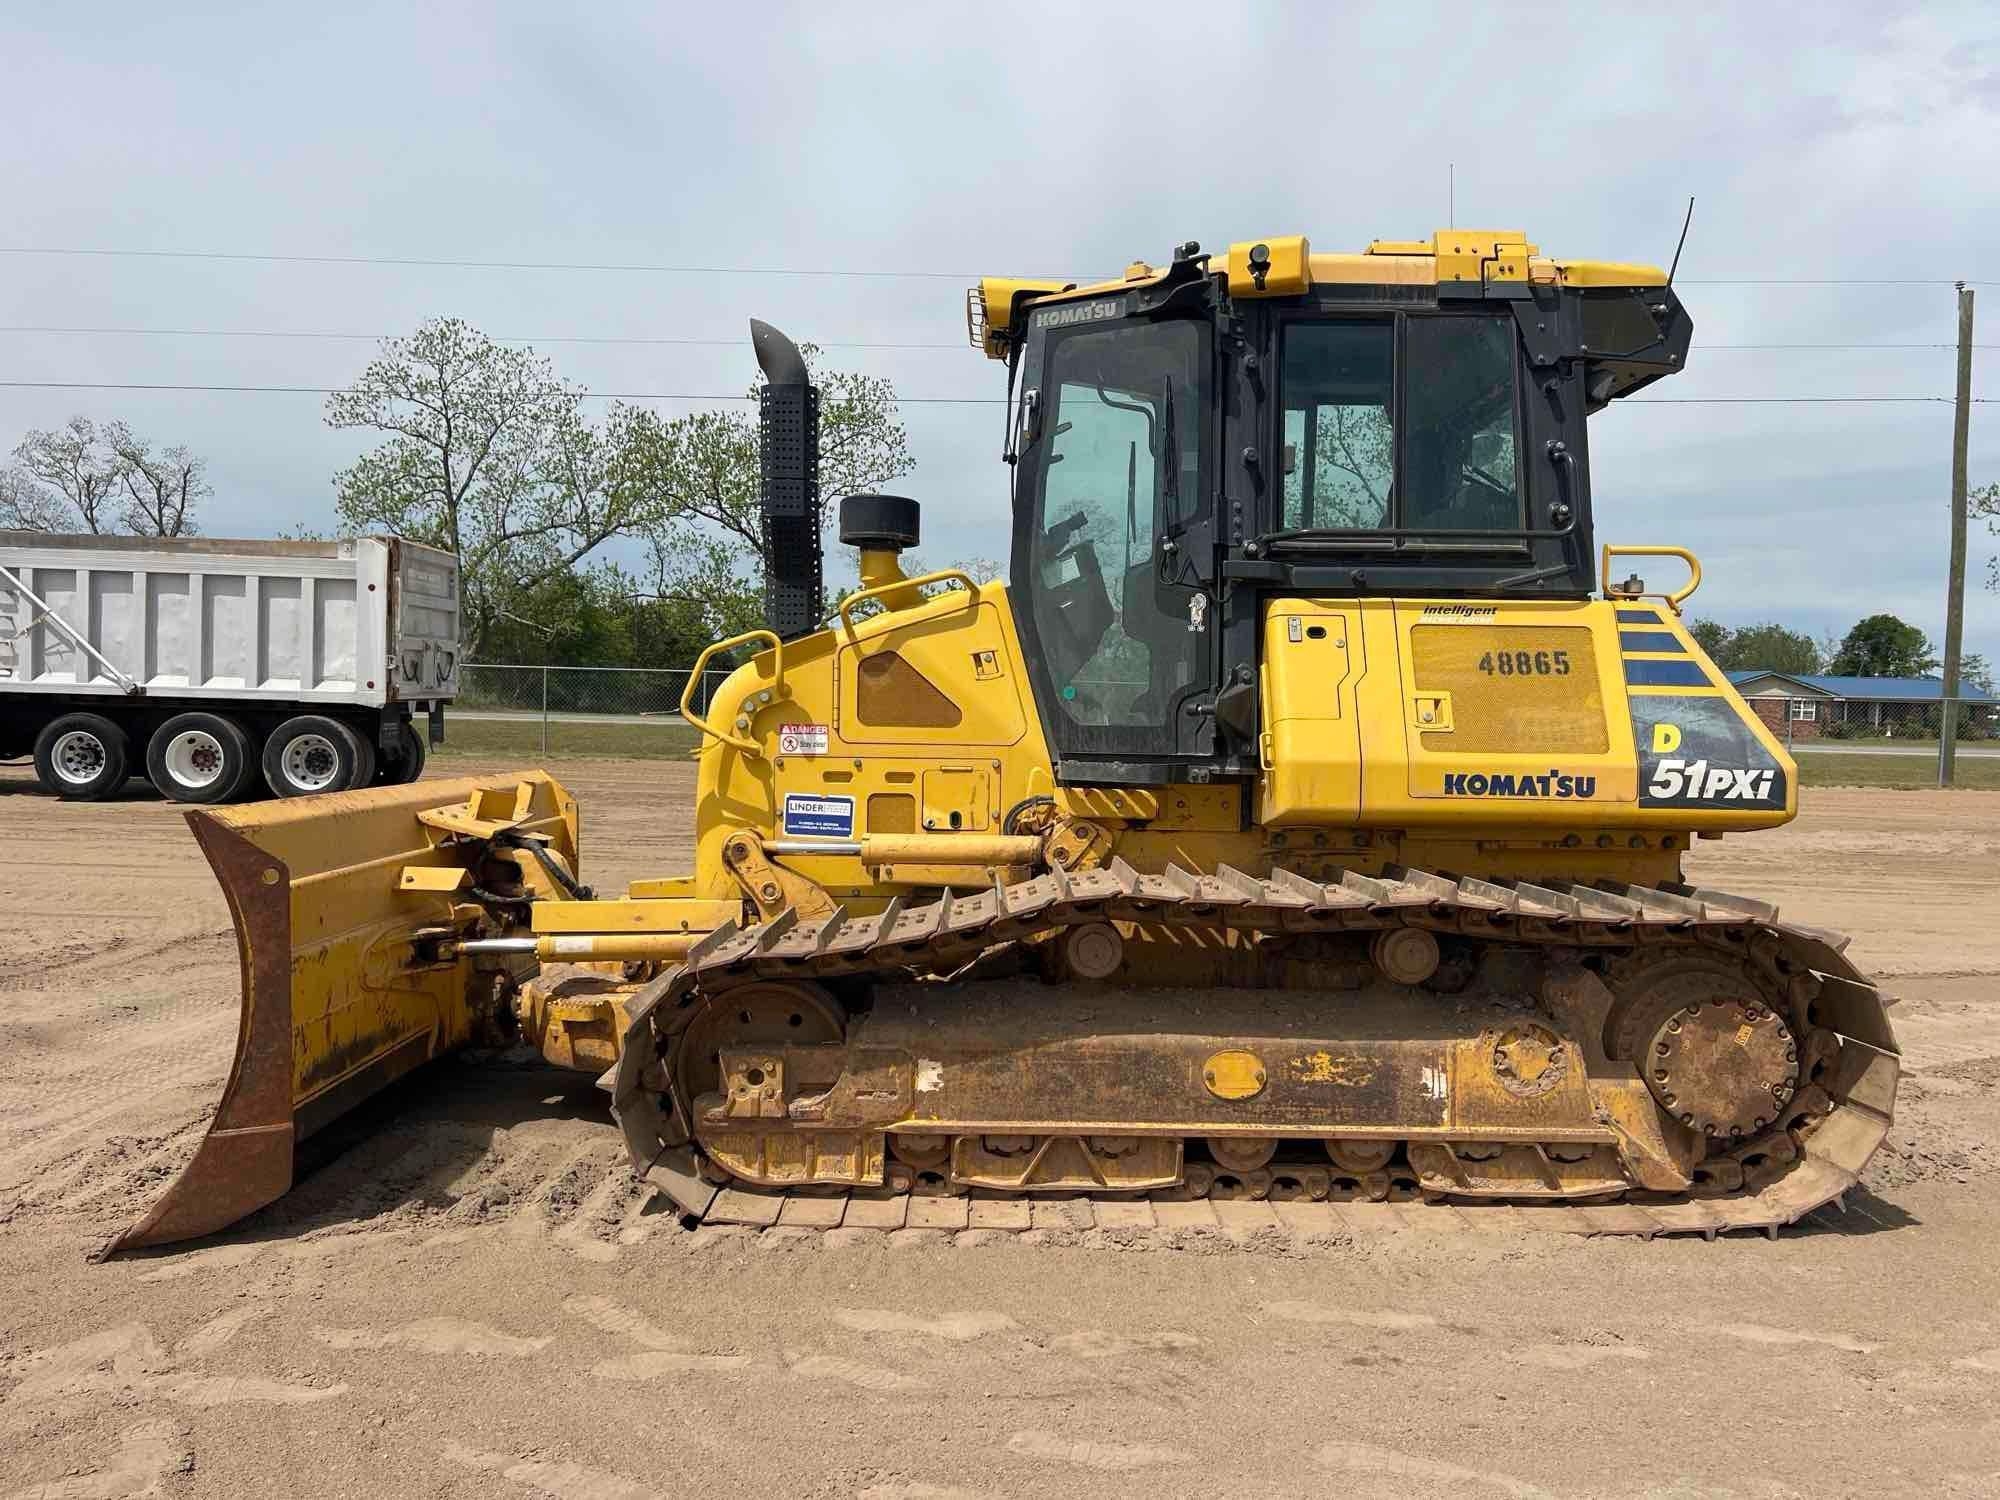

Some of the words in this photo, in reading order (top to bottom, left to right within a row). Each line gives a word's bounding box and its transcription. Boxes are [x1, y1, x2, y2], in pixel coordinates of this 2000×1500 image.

[1036, 301, 1116, 327] KOMATSU
[1424, 604, 1498, 617] intelligent
[1478, 651, 1570, 676] 48865
[791, 725, 828, 735] DANGER
[1653, 723, 1682, 754] D
[1444, 769, 1596, 798] KOMATSU
[790, 803, 824, 813] LINDER
